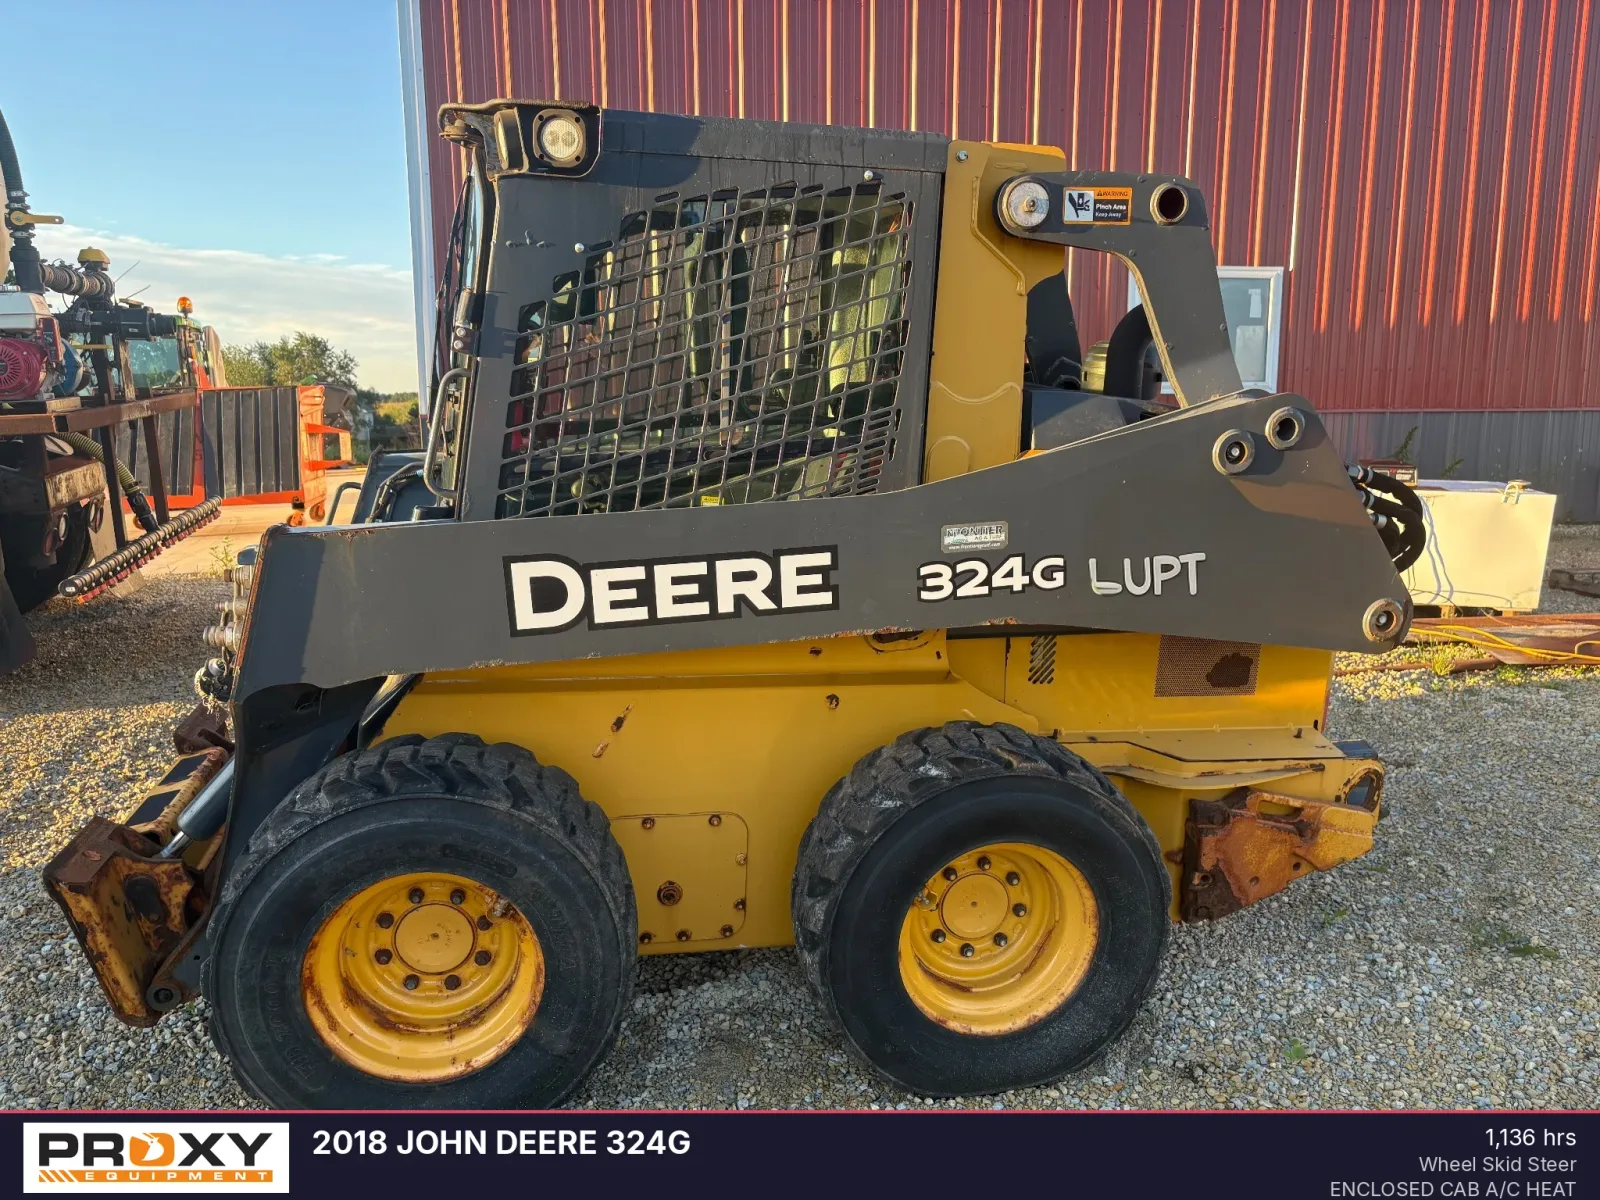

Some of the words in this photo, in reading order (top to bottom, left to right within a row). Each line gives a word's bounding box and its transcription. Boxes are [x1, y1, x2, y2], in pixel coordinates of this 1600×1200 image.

[1108, 211, 1122, 219] Away
[508, 550, 834, 632] DEERE
[918, 555, 1066, 601] 324G
[1088, 552, 1207, 596] LUPT
